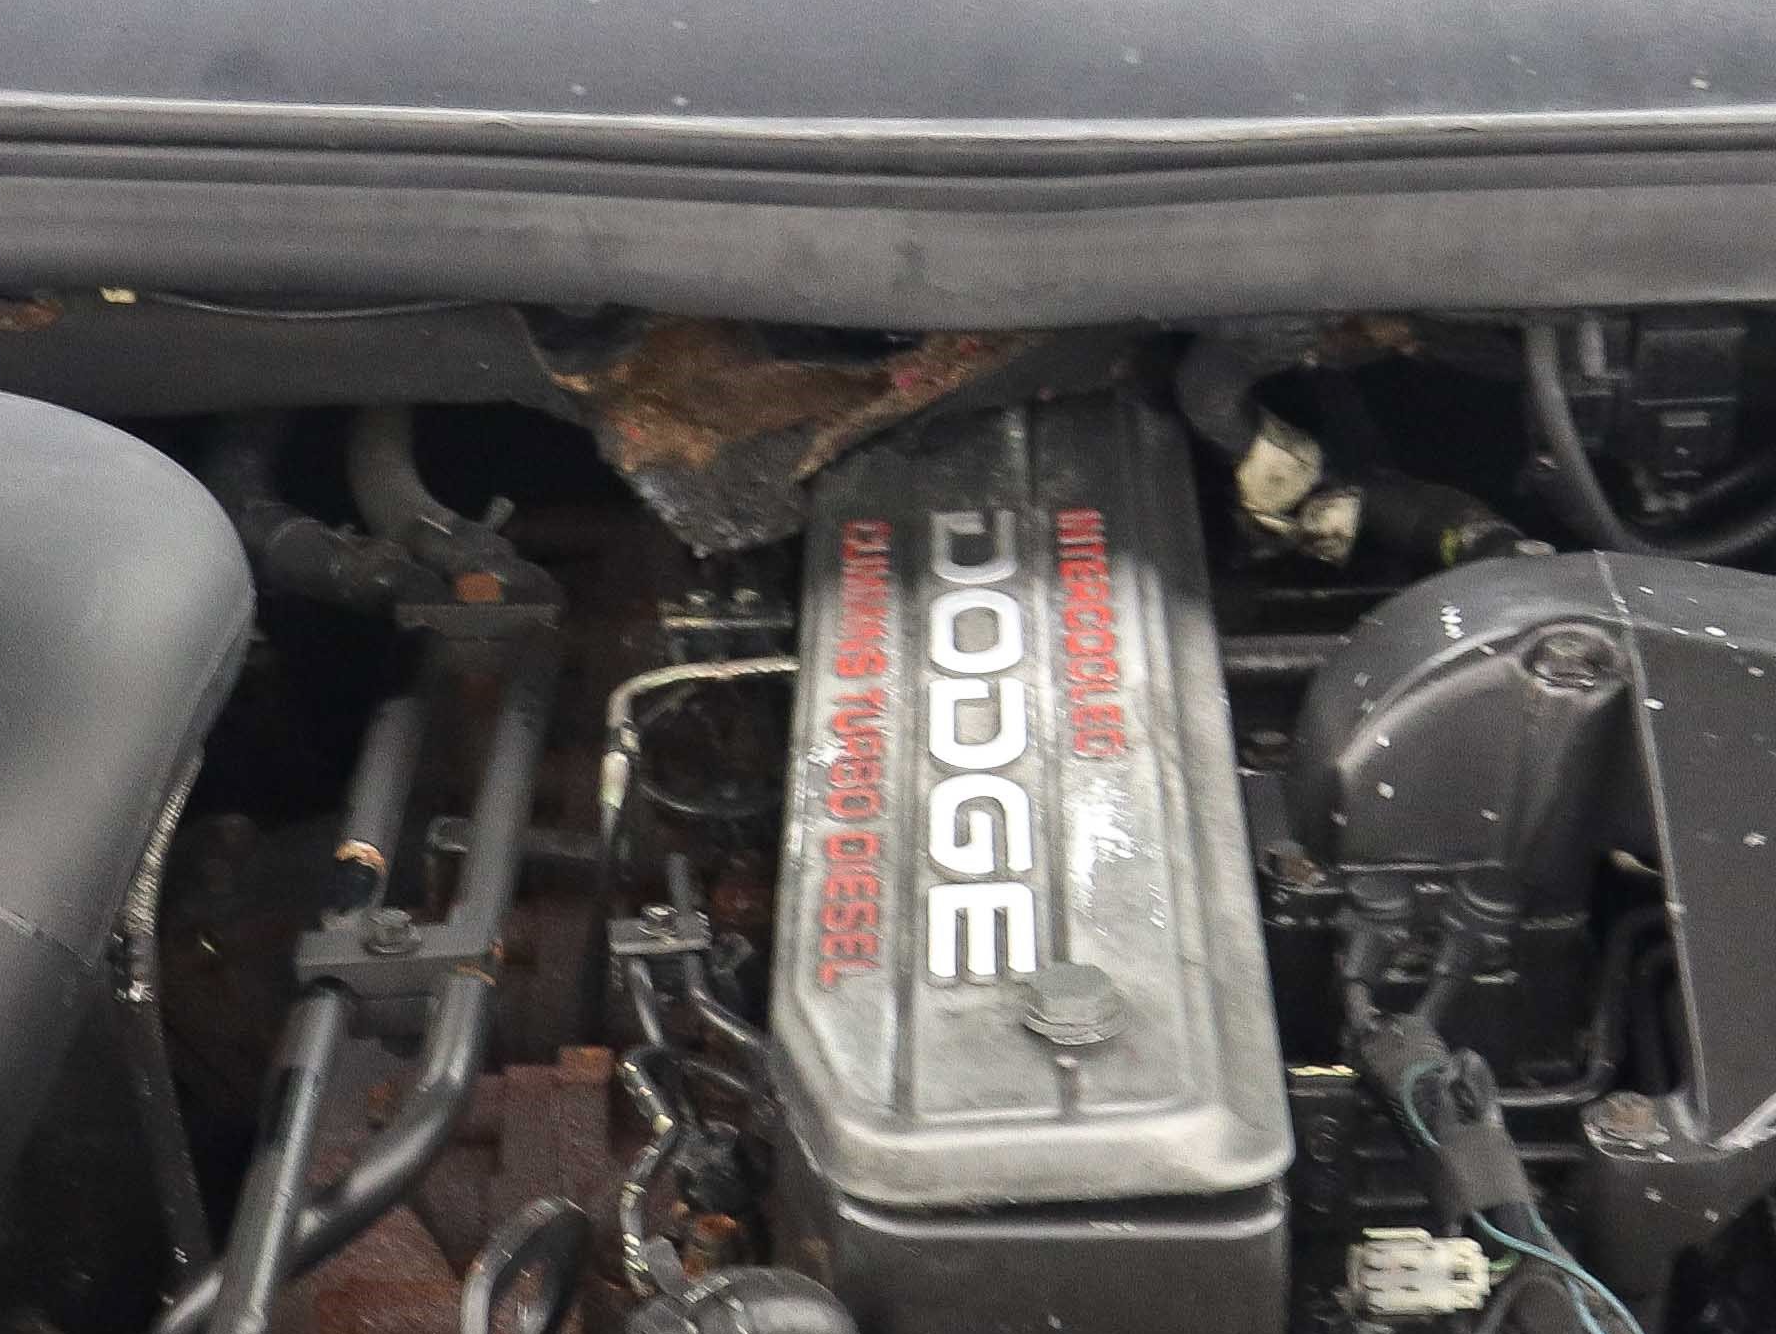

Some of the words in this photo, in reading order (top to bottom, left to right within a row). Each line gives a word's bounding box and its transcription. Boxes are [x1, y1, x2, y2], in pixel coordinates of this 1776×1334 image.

[825, 686, 889, 823] TURBO
[928, 510, 1037, 979] DODGE
[817, 830, 882, 988] DIESEL
